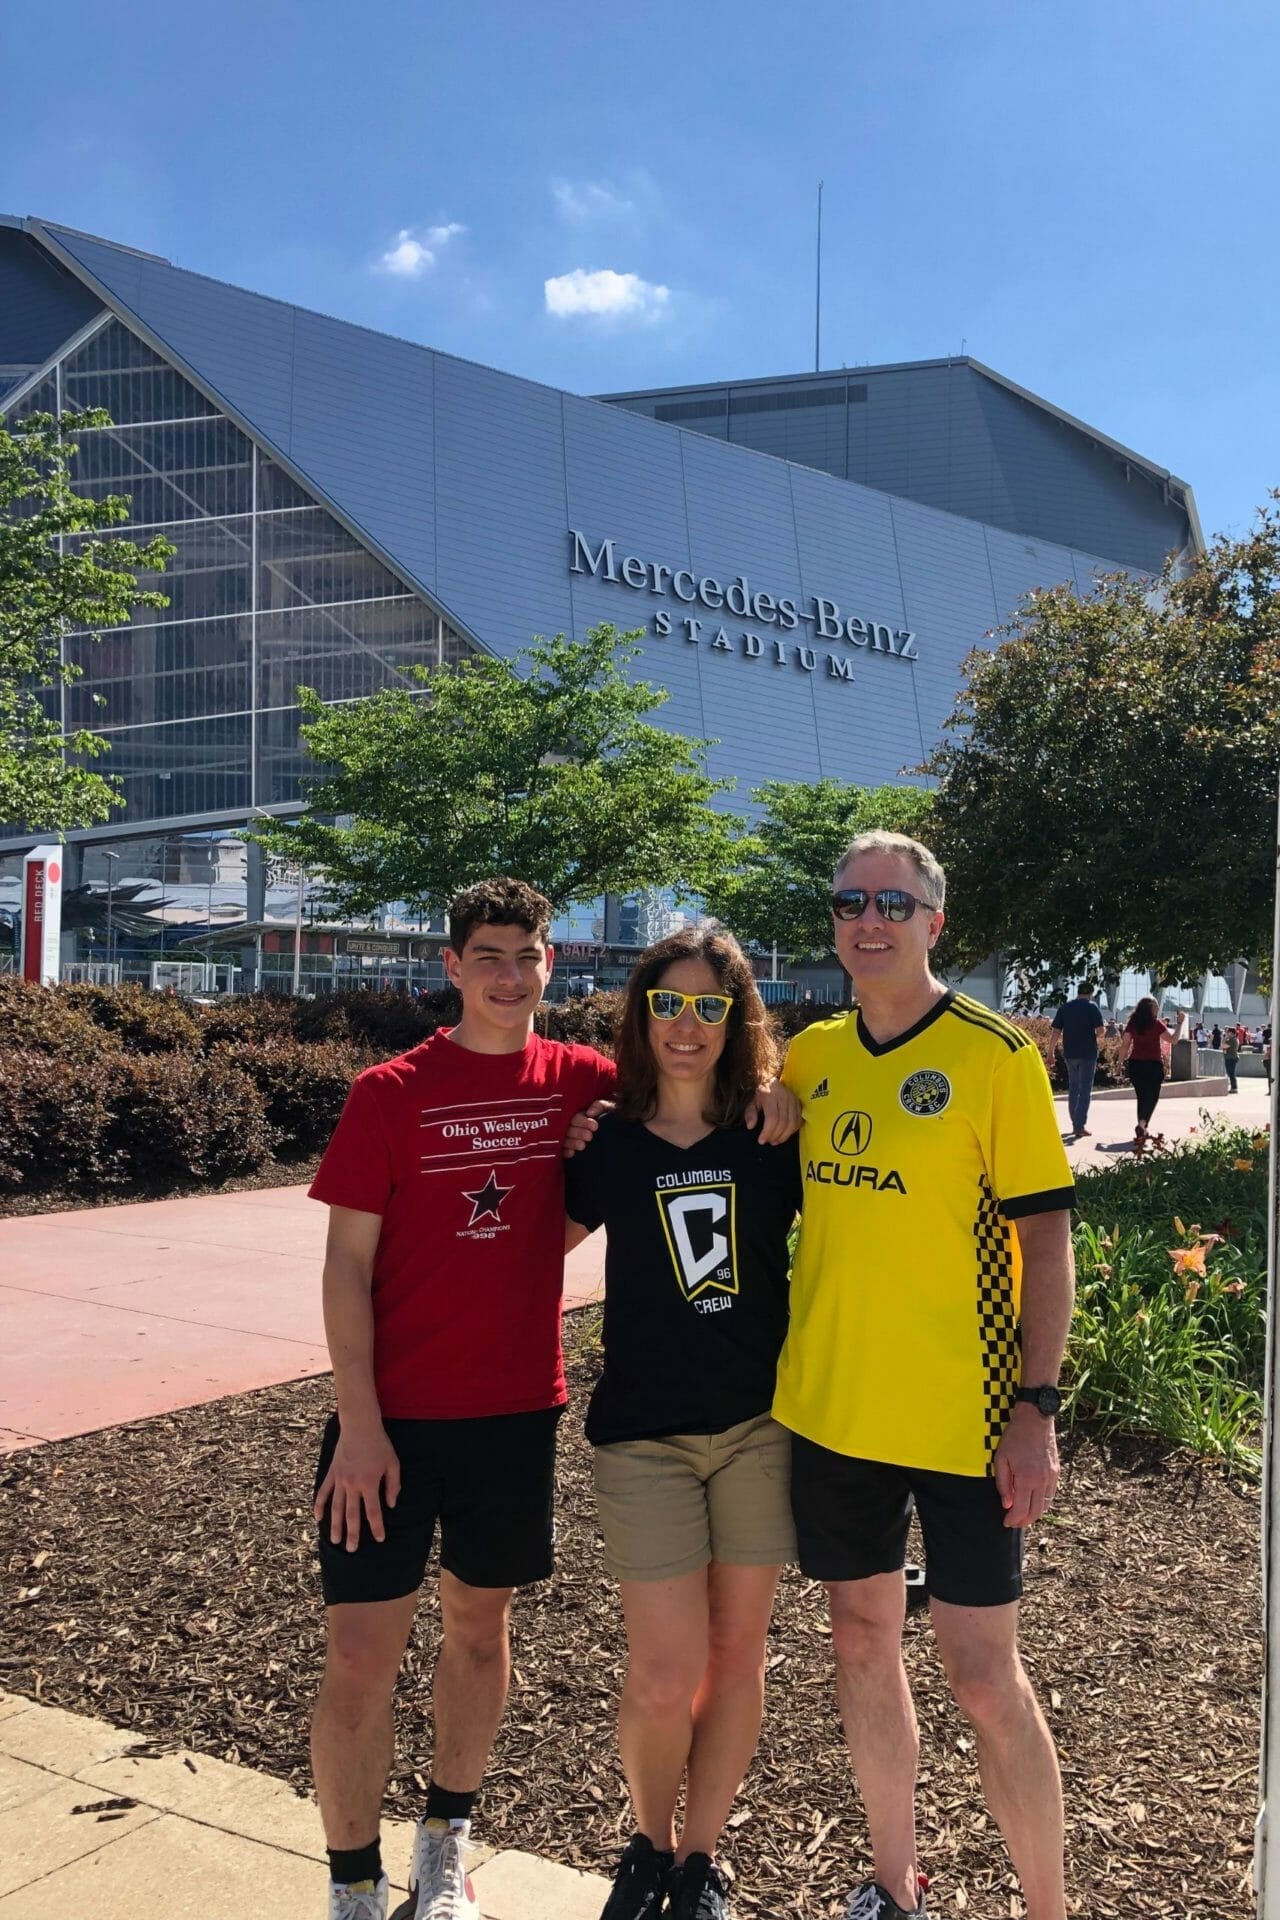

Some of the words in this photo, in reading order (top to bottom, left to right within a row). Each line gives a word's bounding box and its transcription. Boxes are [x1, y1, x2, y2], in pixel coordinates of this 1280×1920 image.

[568, 529, 920, 661] Mercedes-Benz
[655, 610, 855, 681] STADIUM
[34, 869, 44, 897] DECK
[33, 901, 43, 922] RED
[562, 942, 595, 958] GATE
[599, 944, 608, 958] 2
[908, 1073, 946, 1093] COLUMBUS
[903, 1093, 922, 1112] CREW
[928, 1101, 941, 1111] SC
[442, 1123, 479, 1138] Ohio
[483, 1117, 548, 1133] Wesleyan
[472, 1136, 522, 1150] Soccer
[656, 1169, 732, 1188] COLUMBUS
[805, 1160, 907, 1195] ACURA
[717, 1267, 732, 1280] 96
[694, 1295, 732, 1314] CREW
